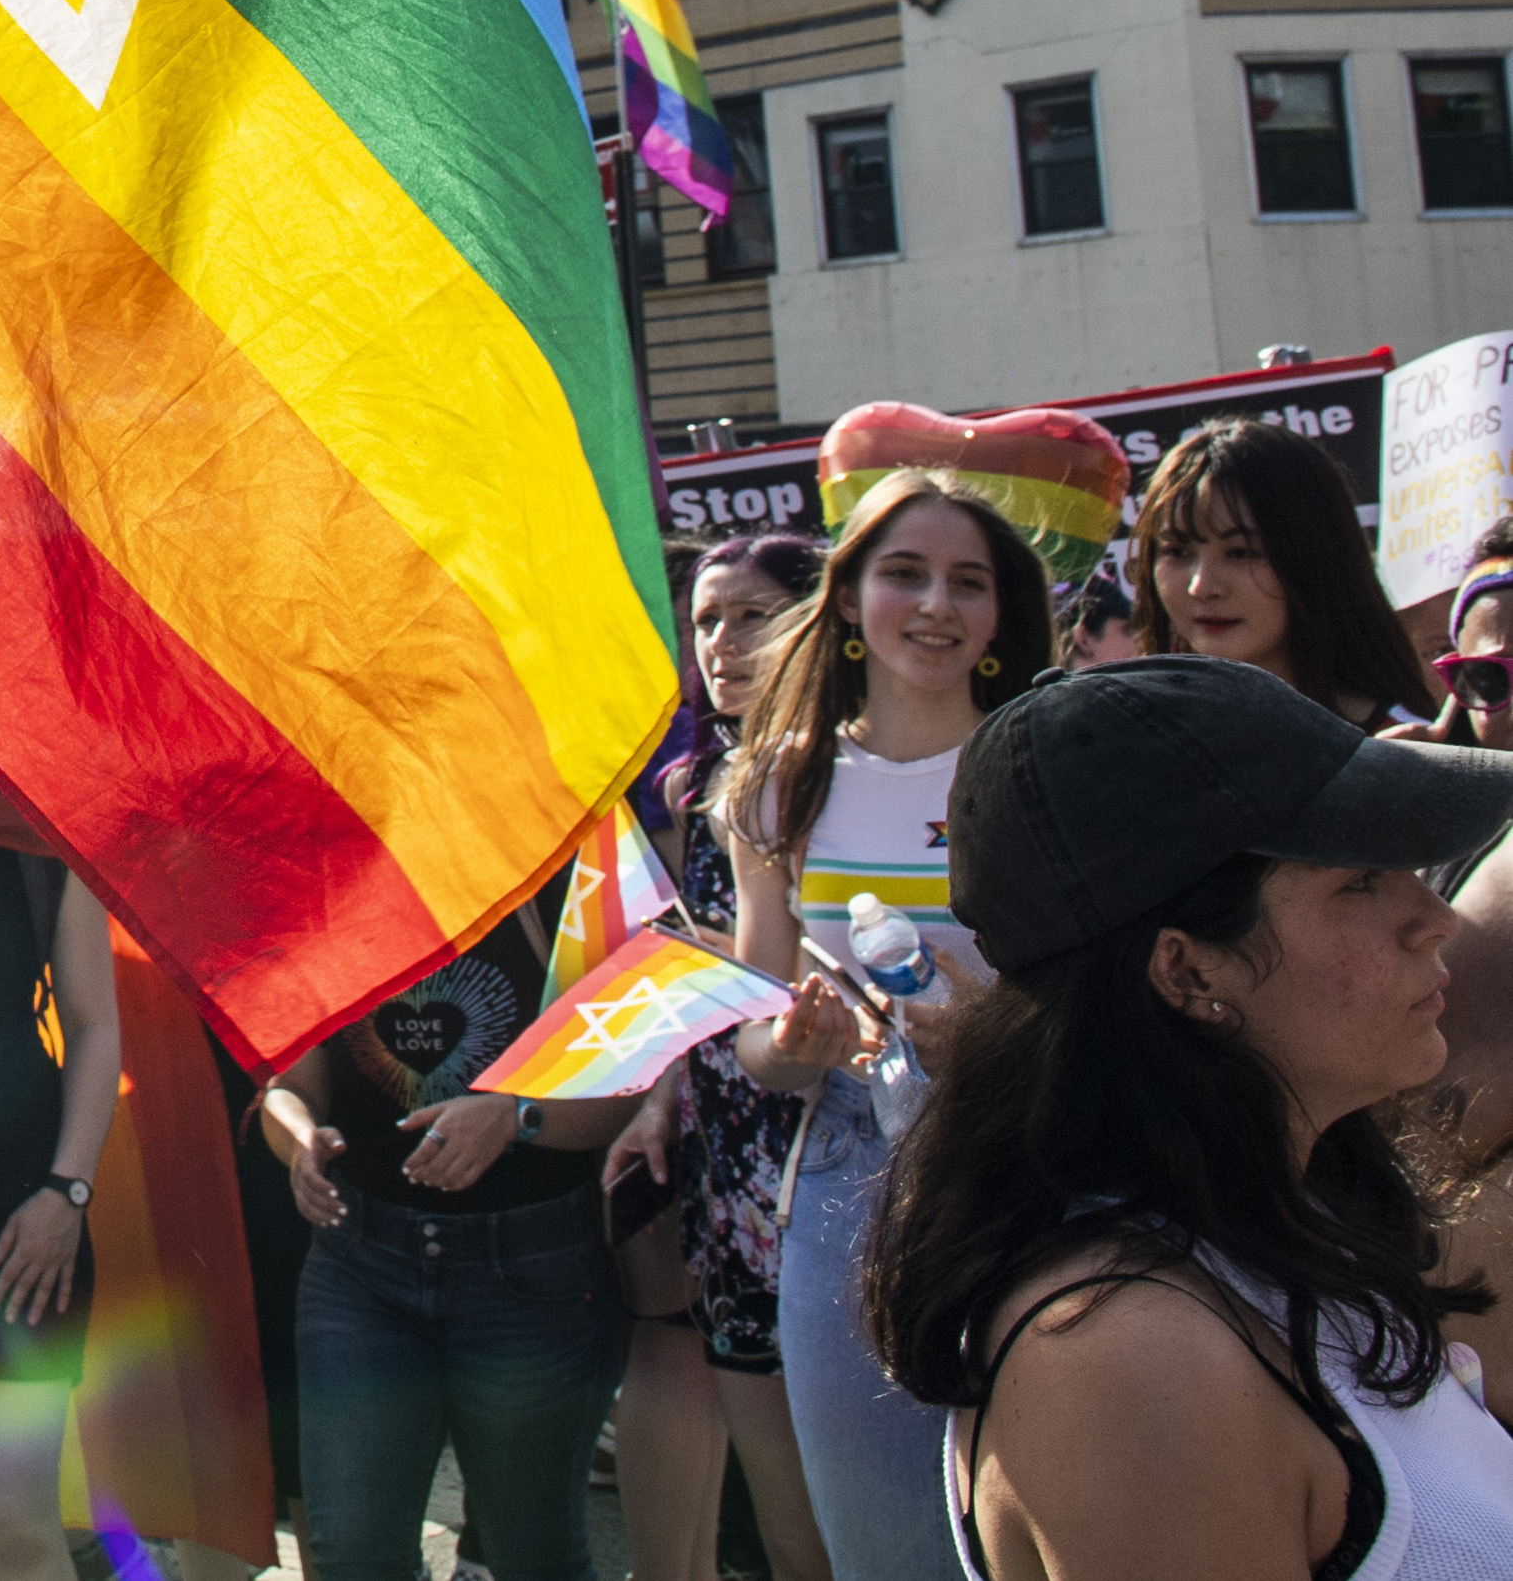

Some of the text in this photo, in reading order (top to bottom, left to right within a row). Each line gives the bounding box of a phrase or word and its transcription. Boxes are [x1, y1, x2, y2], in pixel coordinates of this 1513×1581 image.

[669, 481, 805, 529] Stop
[395, 1019, 443, 1031] LOVE
[396, 1039, 445, 1051] LOVE
